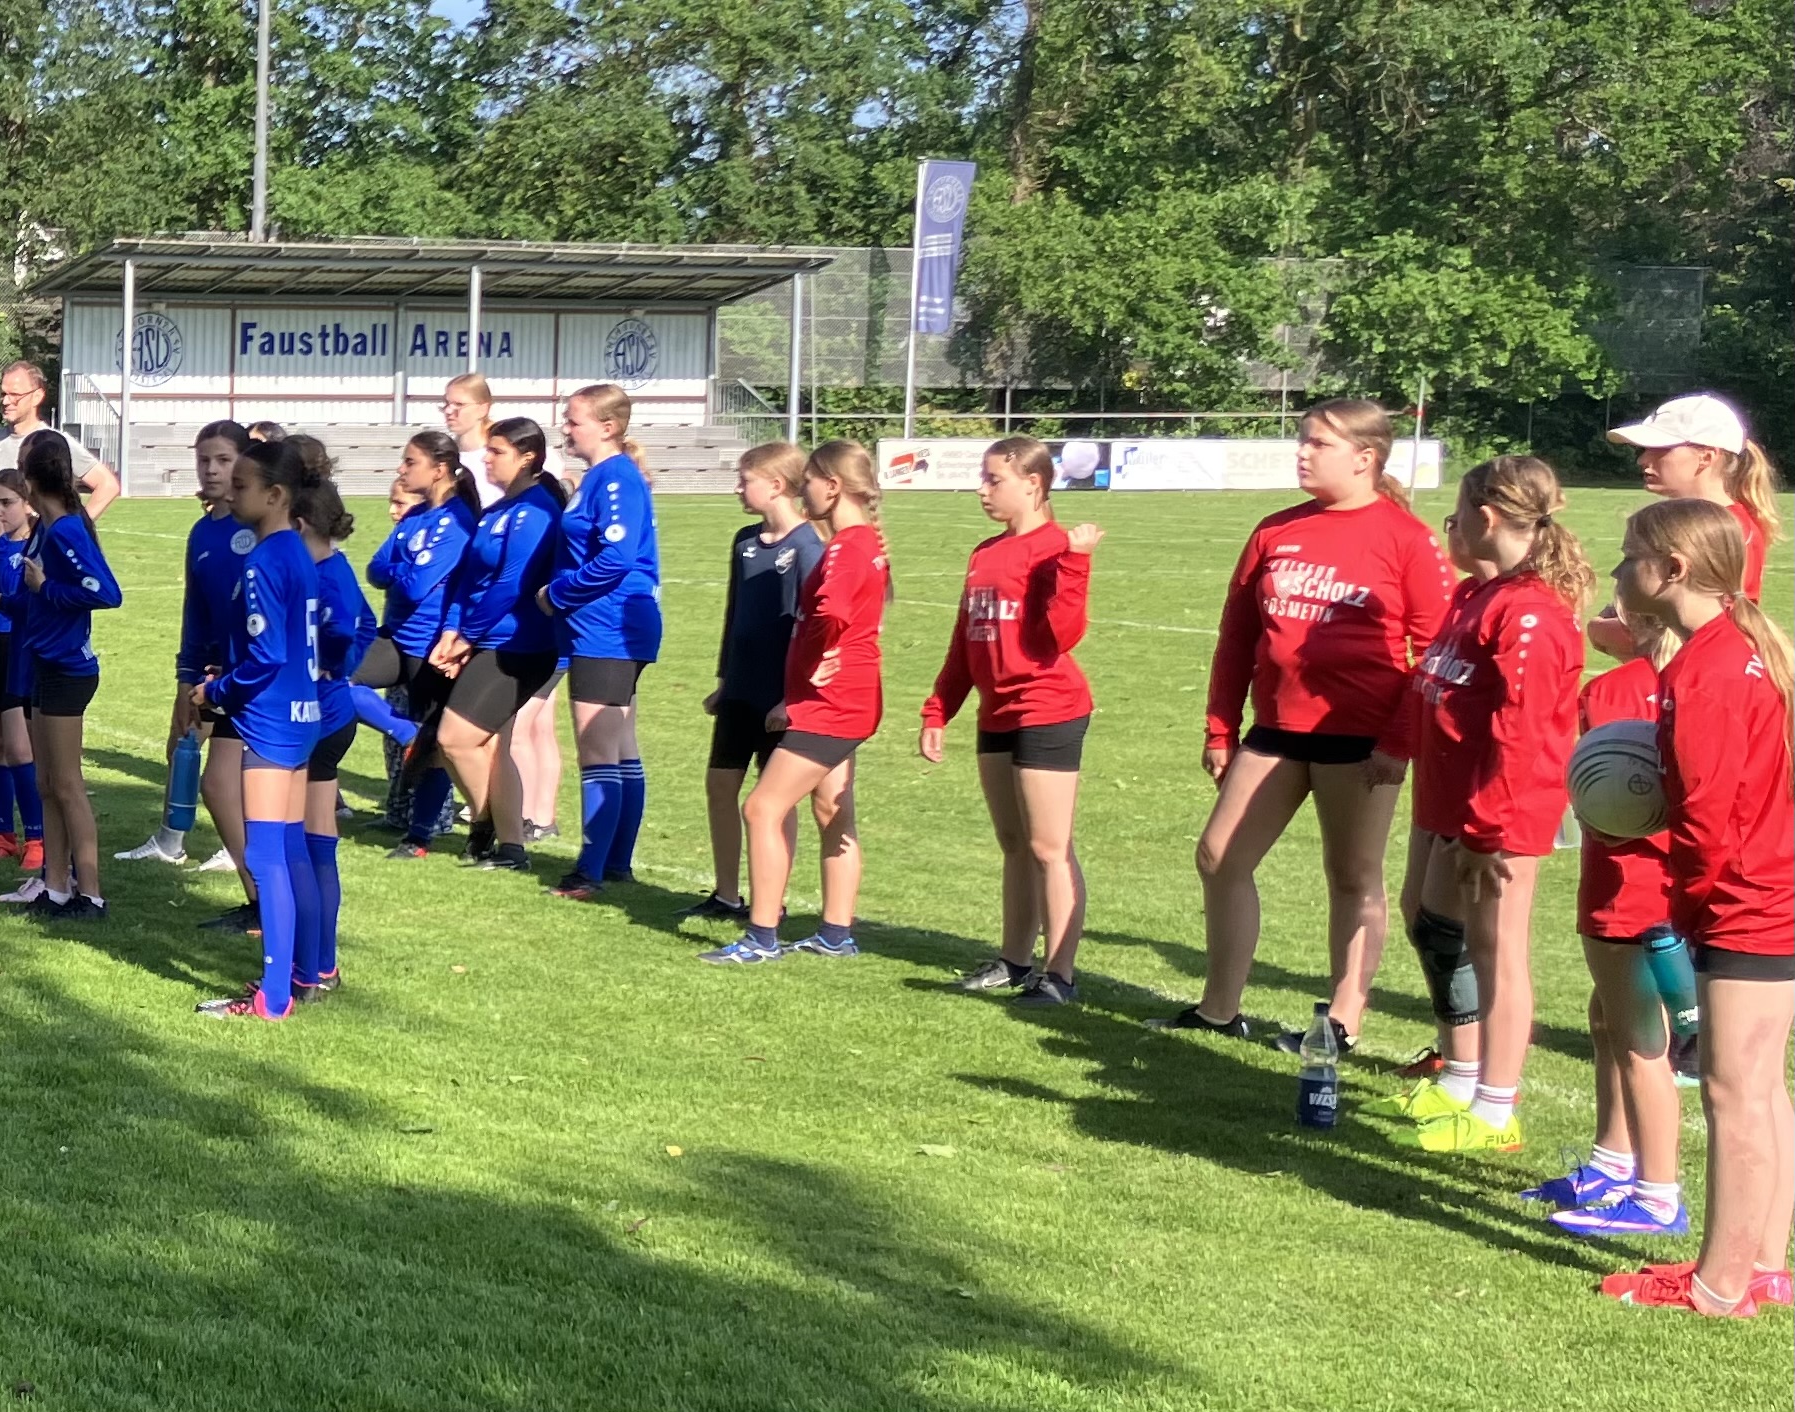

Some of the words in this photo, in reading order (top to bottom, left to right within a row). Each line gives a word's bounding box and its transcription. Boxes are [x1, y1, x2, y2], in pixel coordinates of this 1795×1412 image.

[239, 322, 387, 356] Faustball
[1289, 576, 1370, 608] SCHOLZ
[1485, 1133, 1517, 1149] FILA
